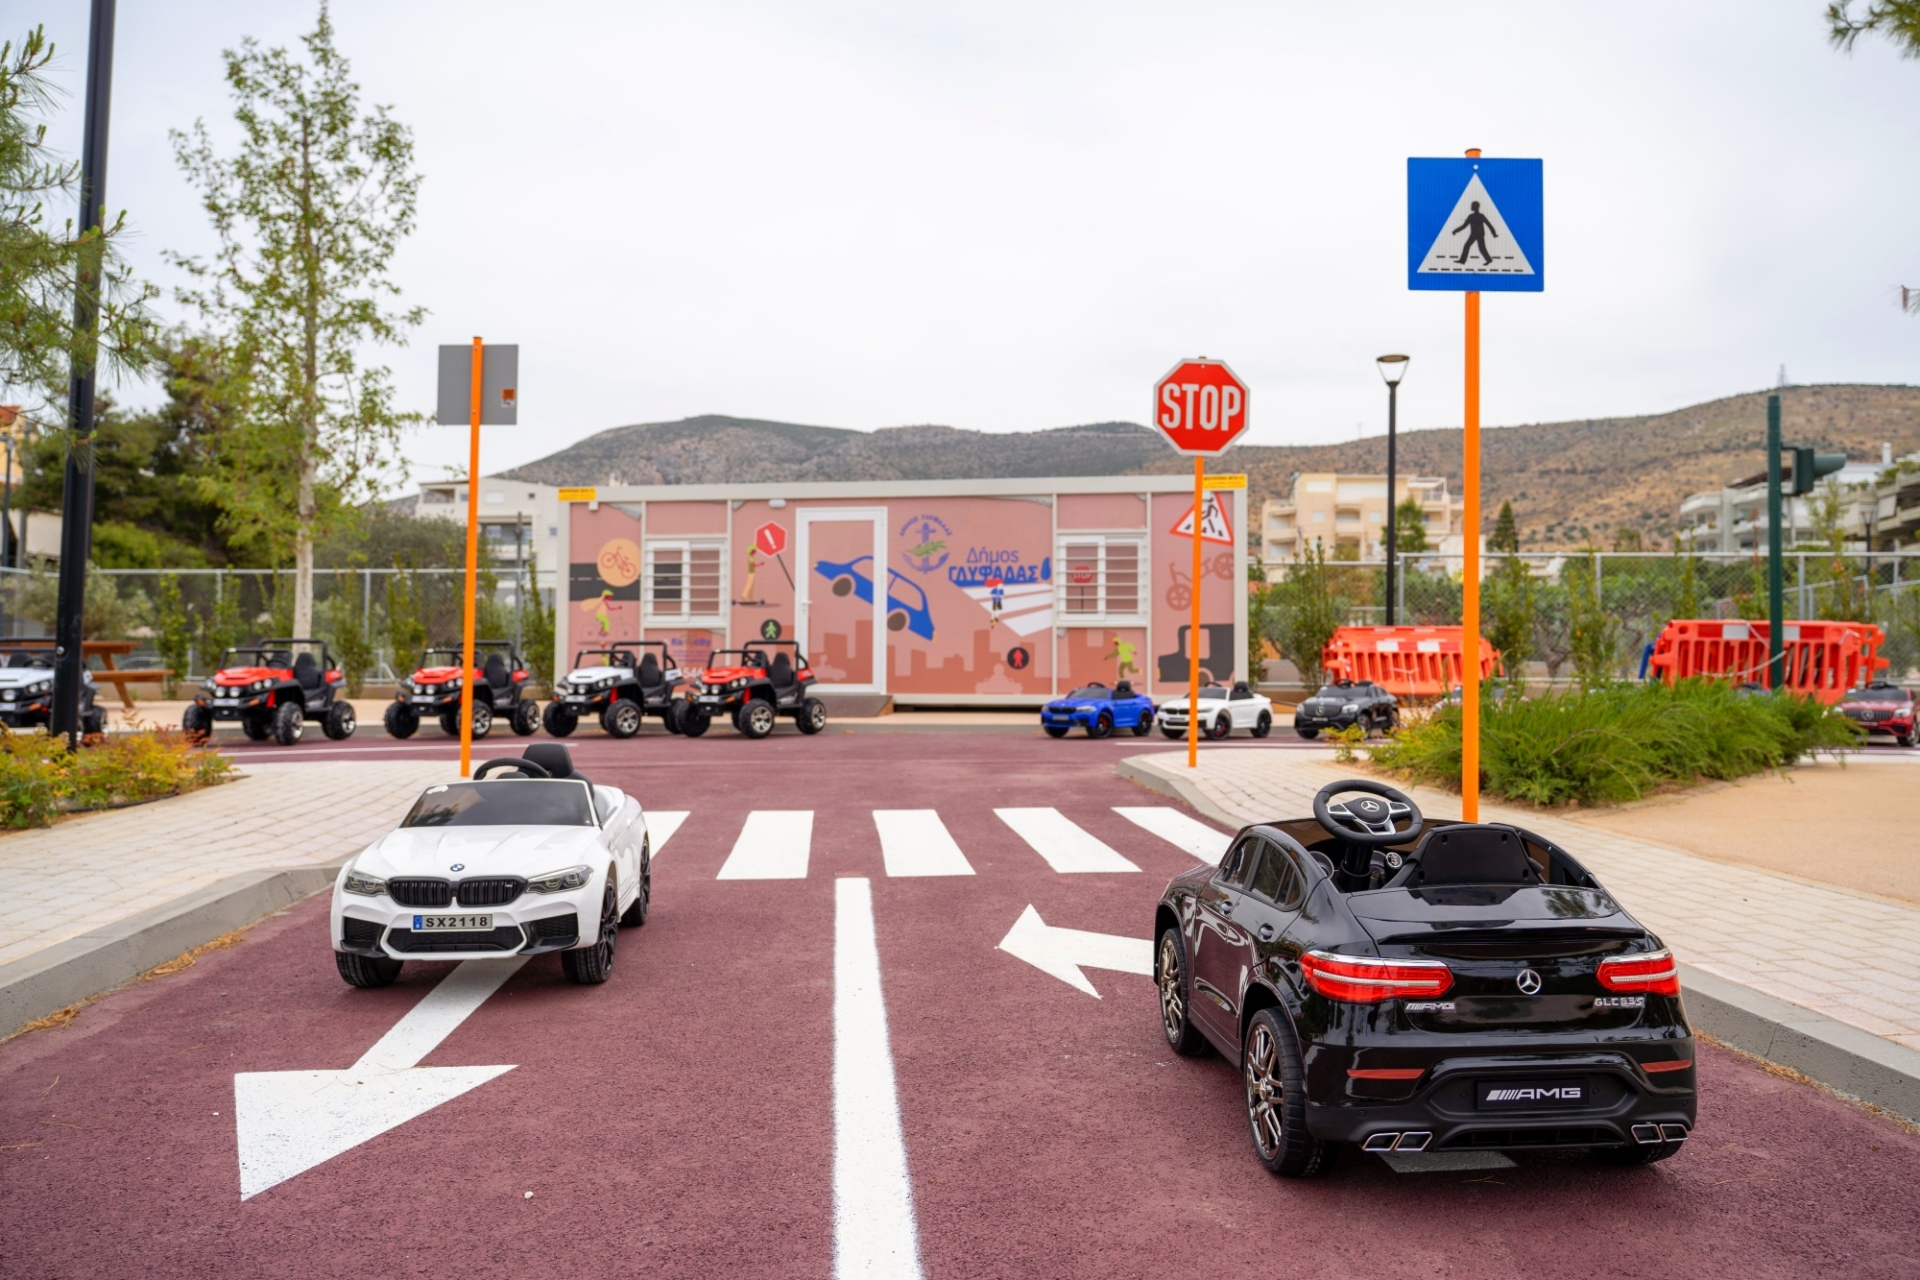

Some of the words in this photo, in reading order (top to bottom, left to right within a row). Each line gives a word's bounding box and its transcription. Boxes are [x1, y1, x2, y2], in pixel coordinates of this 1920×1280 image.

[1161, 382, 1242, 432] STOP
[966, 546, 1019, 566] Δήμος
[425, 916, 488, 928] SX2118
